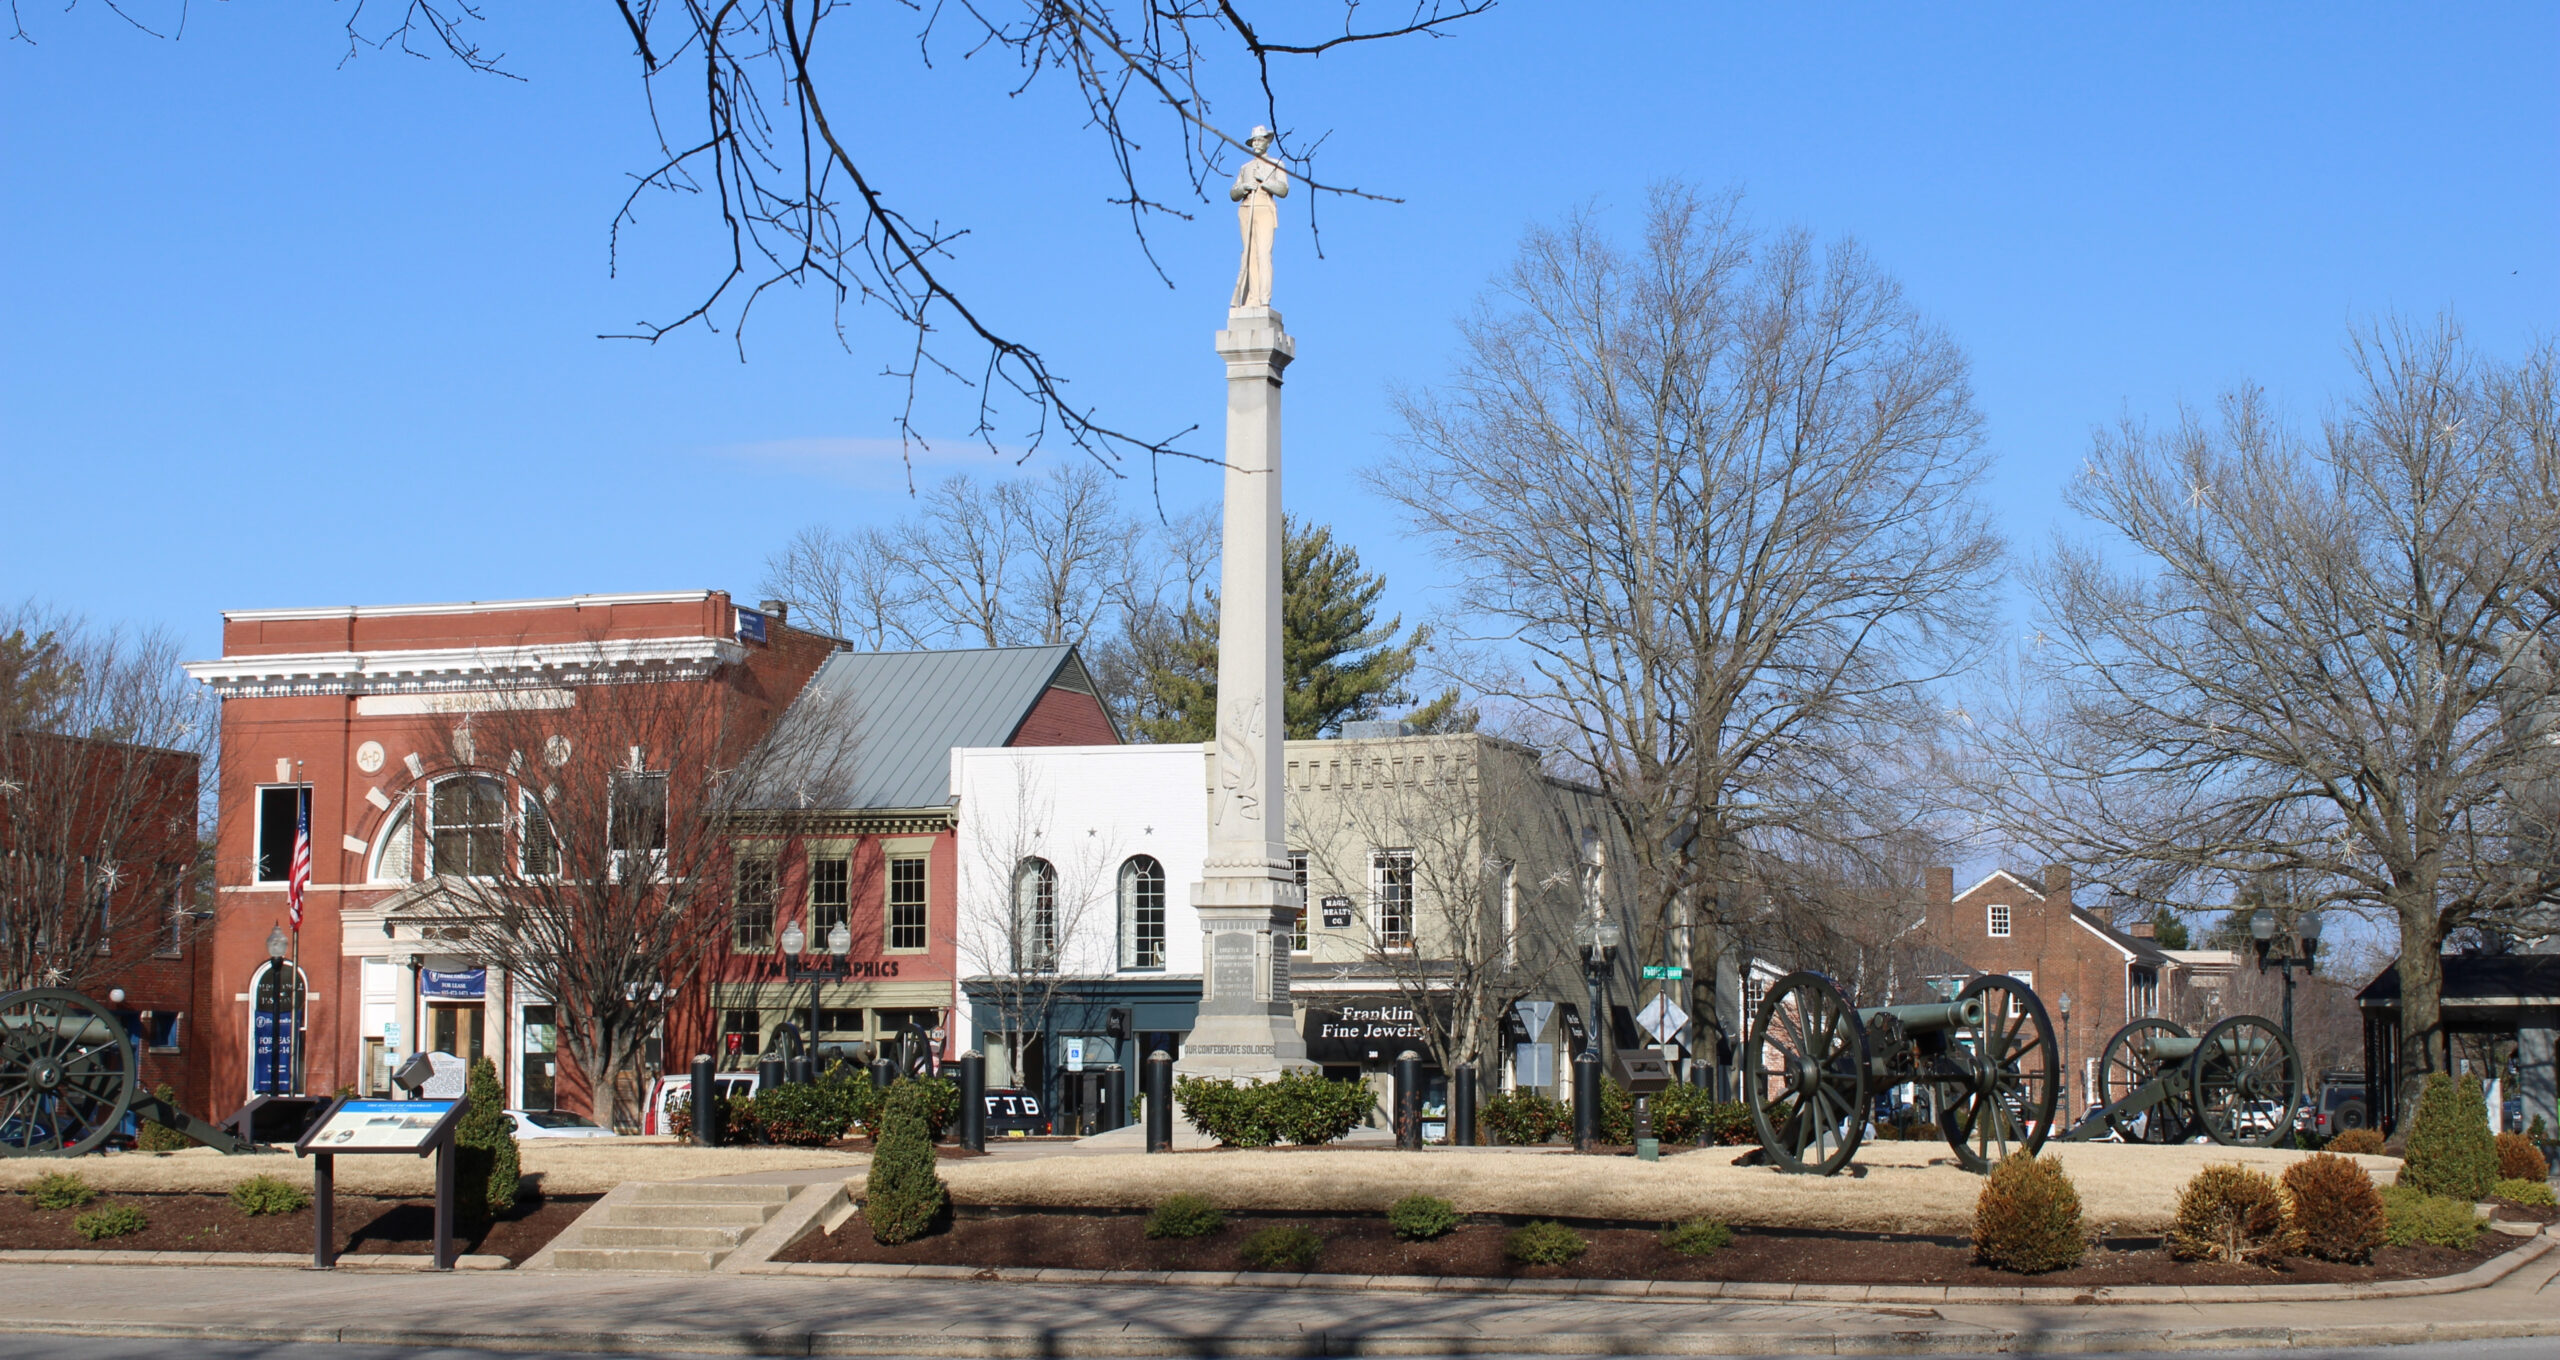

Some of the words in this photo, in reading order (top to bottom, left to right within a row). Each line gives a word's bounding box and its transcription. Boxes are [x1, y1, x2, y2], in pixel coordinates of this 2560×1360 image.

[1323, 908, 1351, 916] REALTY
[820, 961, 899, 976] GAPHICS
[1341, 1006, 1414, 1020] Franklin
[1321, 1023, 1359, 1038] Fine
[1184, 1044, 1197, 1055] OUR
[1197, 1044, 1241, 1055] CONFEDERATE
[1241, 1044, 1275, 1055] SOLDIERS
